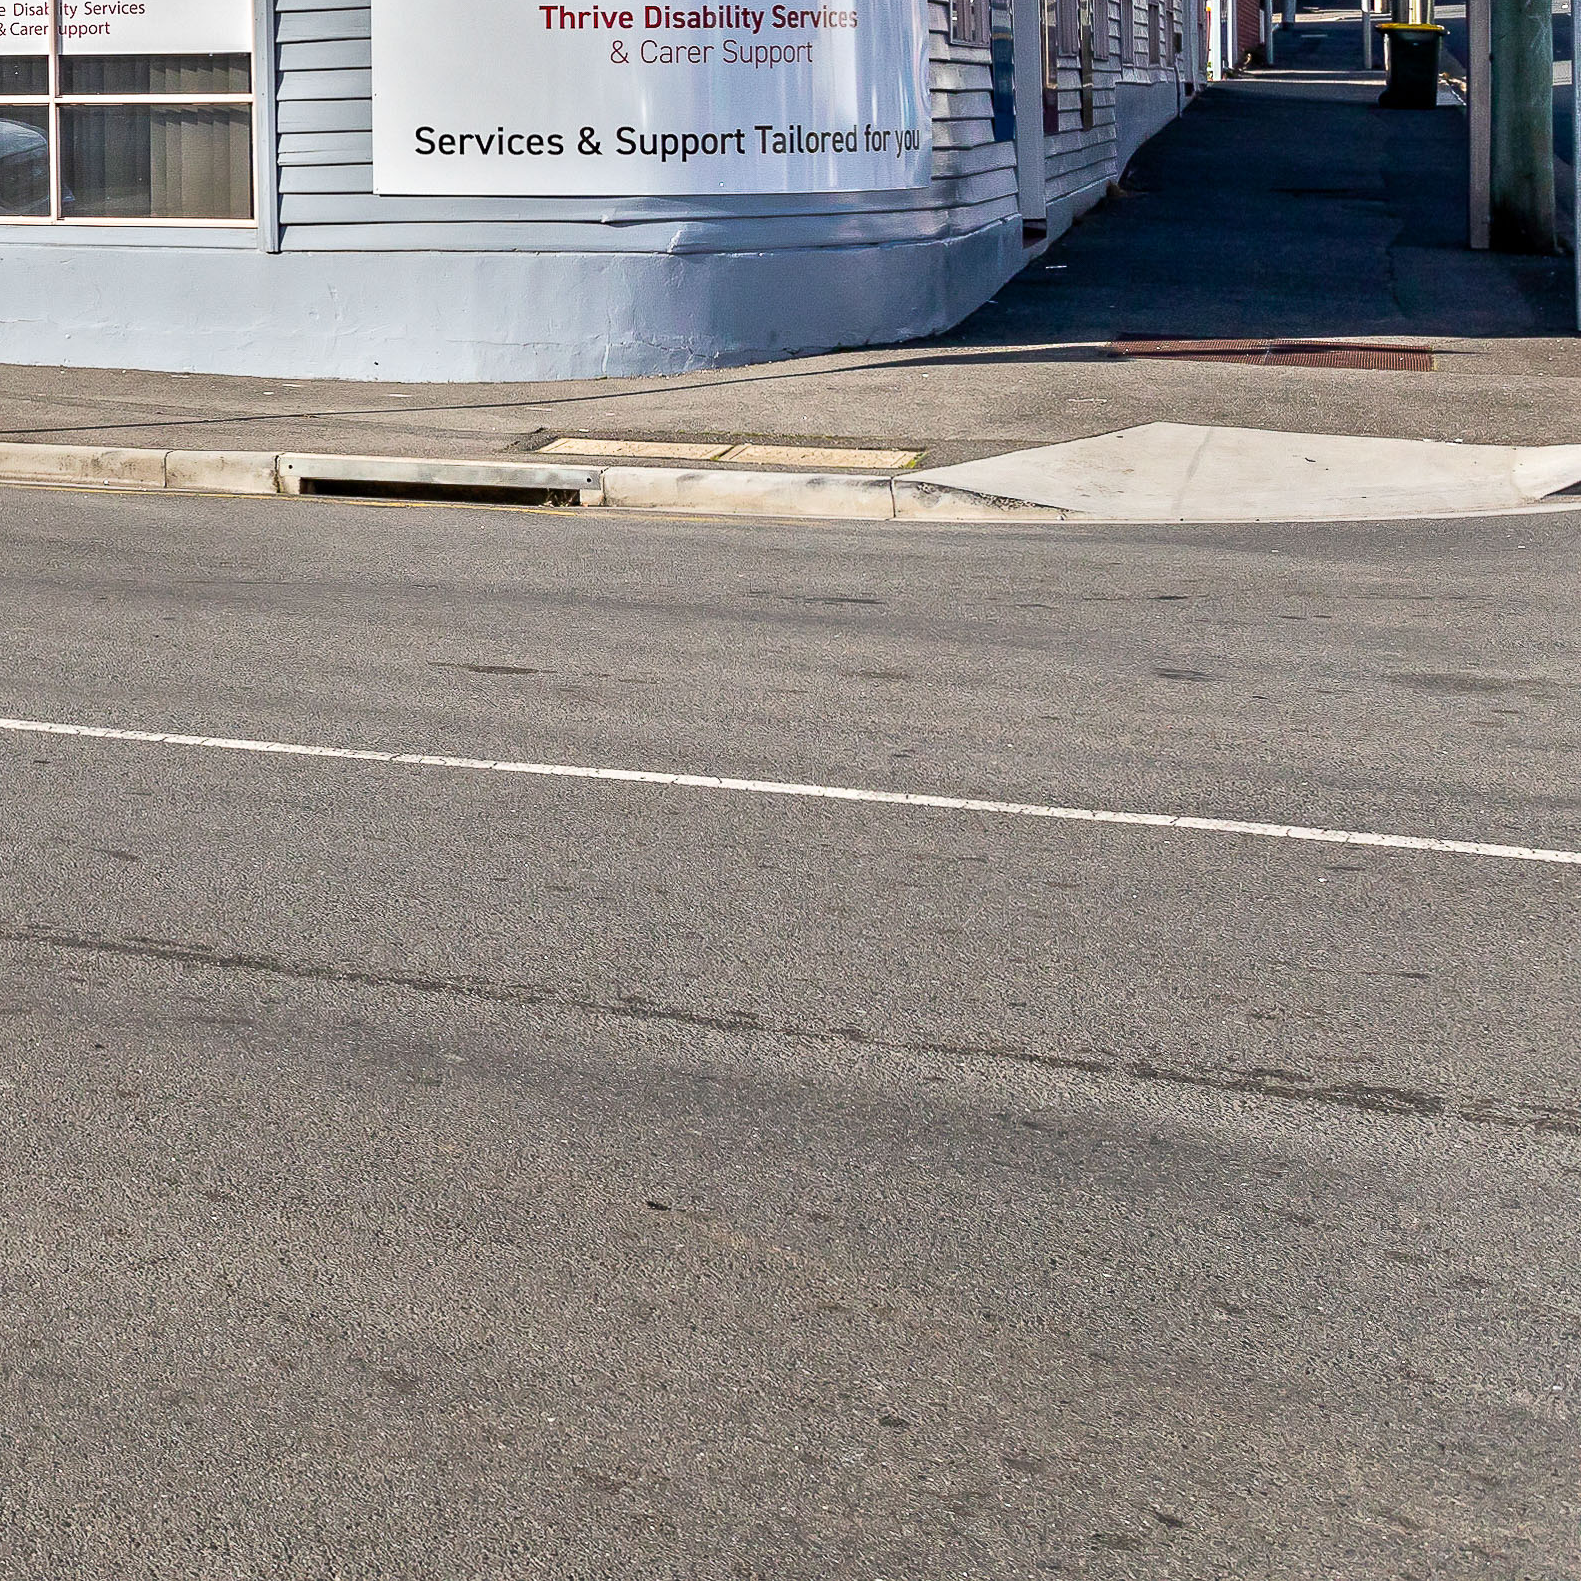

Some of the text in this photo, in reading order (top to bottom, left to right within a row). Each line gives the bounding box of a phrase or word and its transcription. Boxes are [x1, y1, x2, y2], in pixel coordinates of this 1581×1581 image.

[14, 3, 77, 19] Disabity
[84, 1, 145, 15] Services
[539, 5, 858, 34] Thrive Disability Services
[10, 23, 49, 35] Carer
[53, 22, 111, 38] upport
[610, 40, 813, 69] & Carer Support
[415, 125, 921, 161] Services & Support Tailored for you
